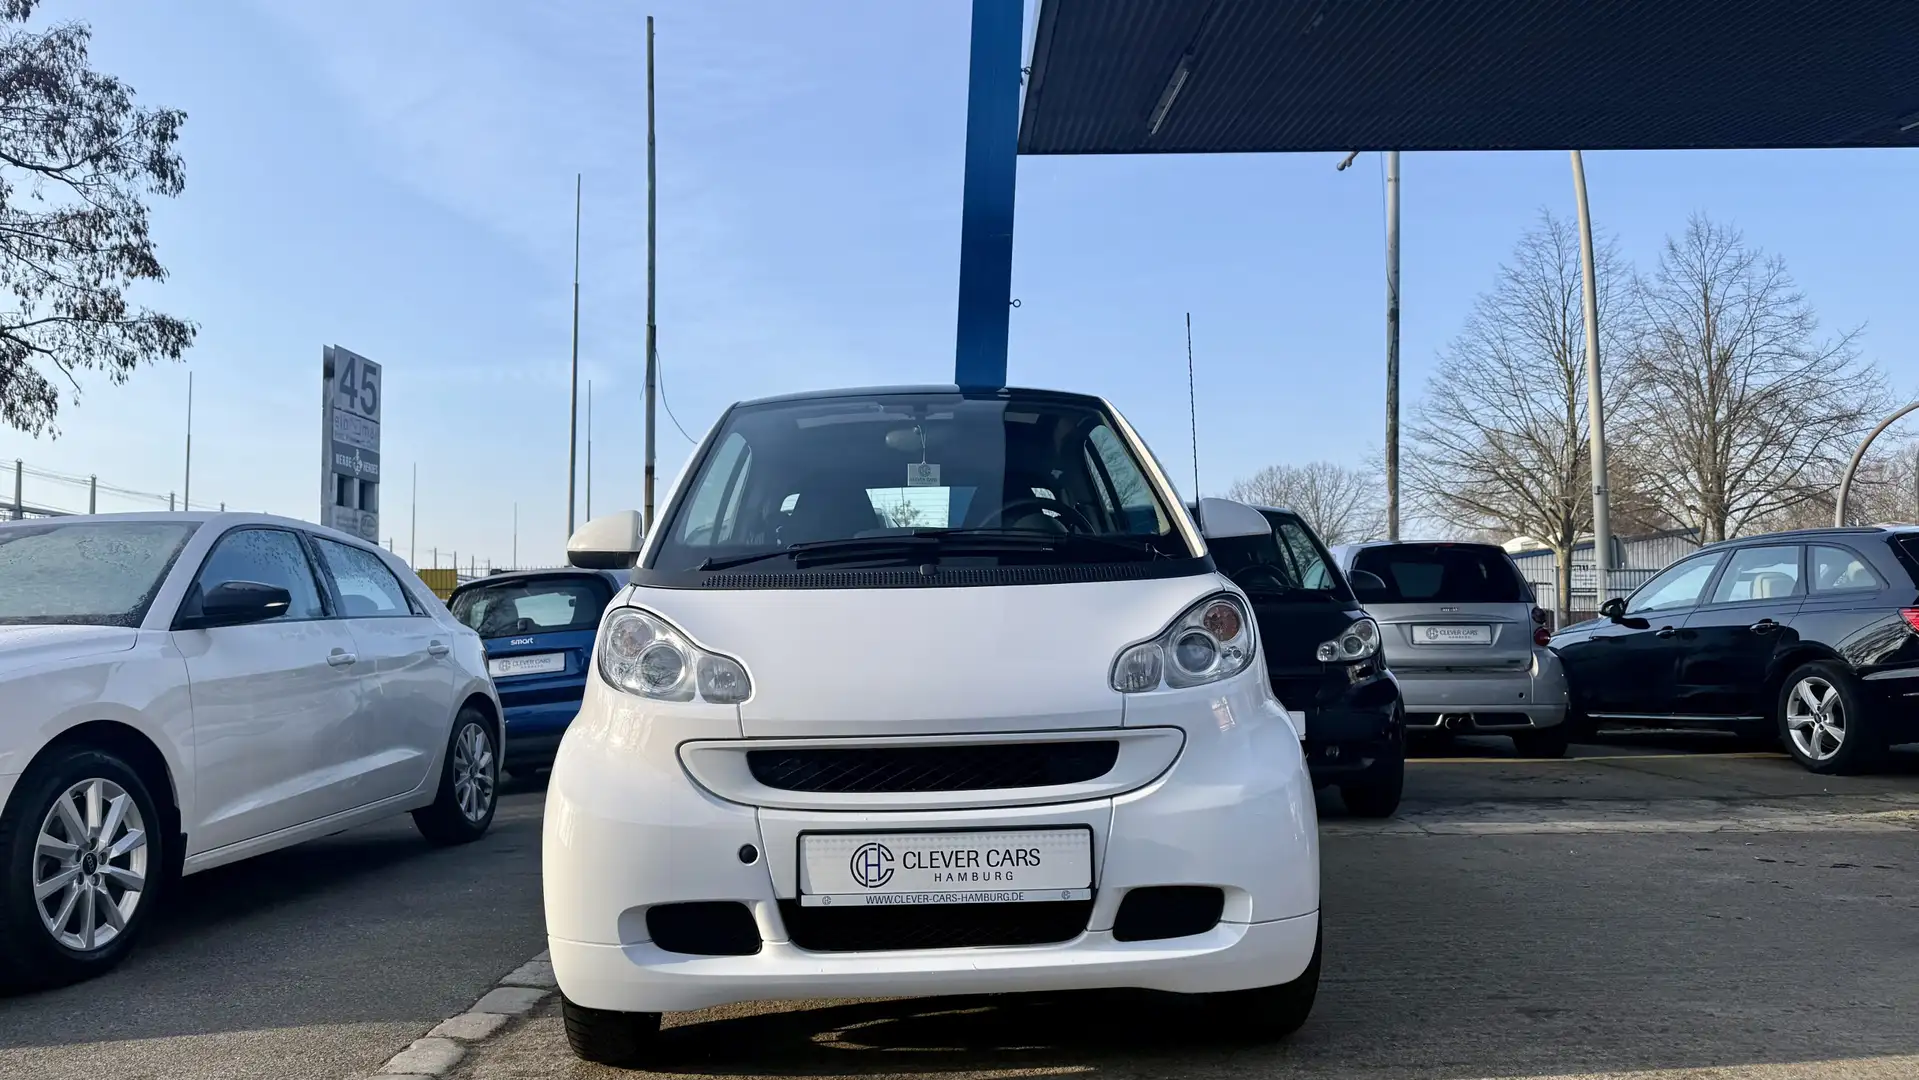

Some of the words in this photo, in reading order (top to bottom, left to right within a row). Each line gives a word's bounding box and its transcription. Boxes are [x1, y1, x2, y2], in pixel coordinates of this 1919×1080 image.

[339, 356, 377, 416] 45
[510, 637, 534, 646] smart
[902, 850, 980, 870] CLEVER
[986, 848, 1041, 868] CARS
[934, 870, 1014, 882] HAMBURG
[865, 891, 1025, 905] WWW.CLEVER-CARS-HAMBURG.DE
